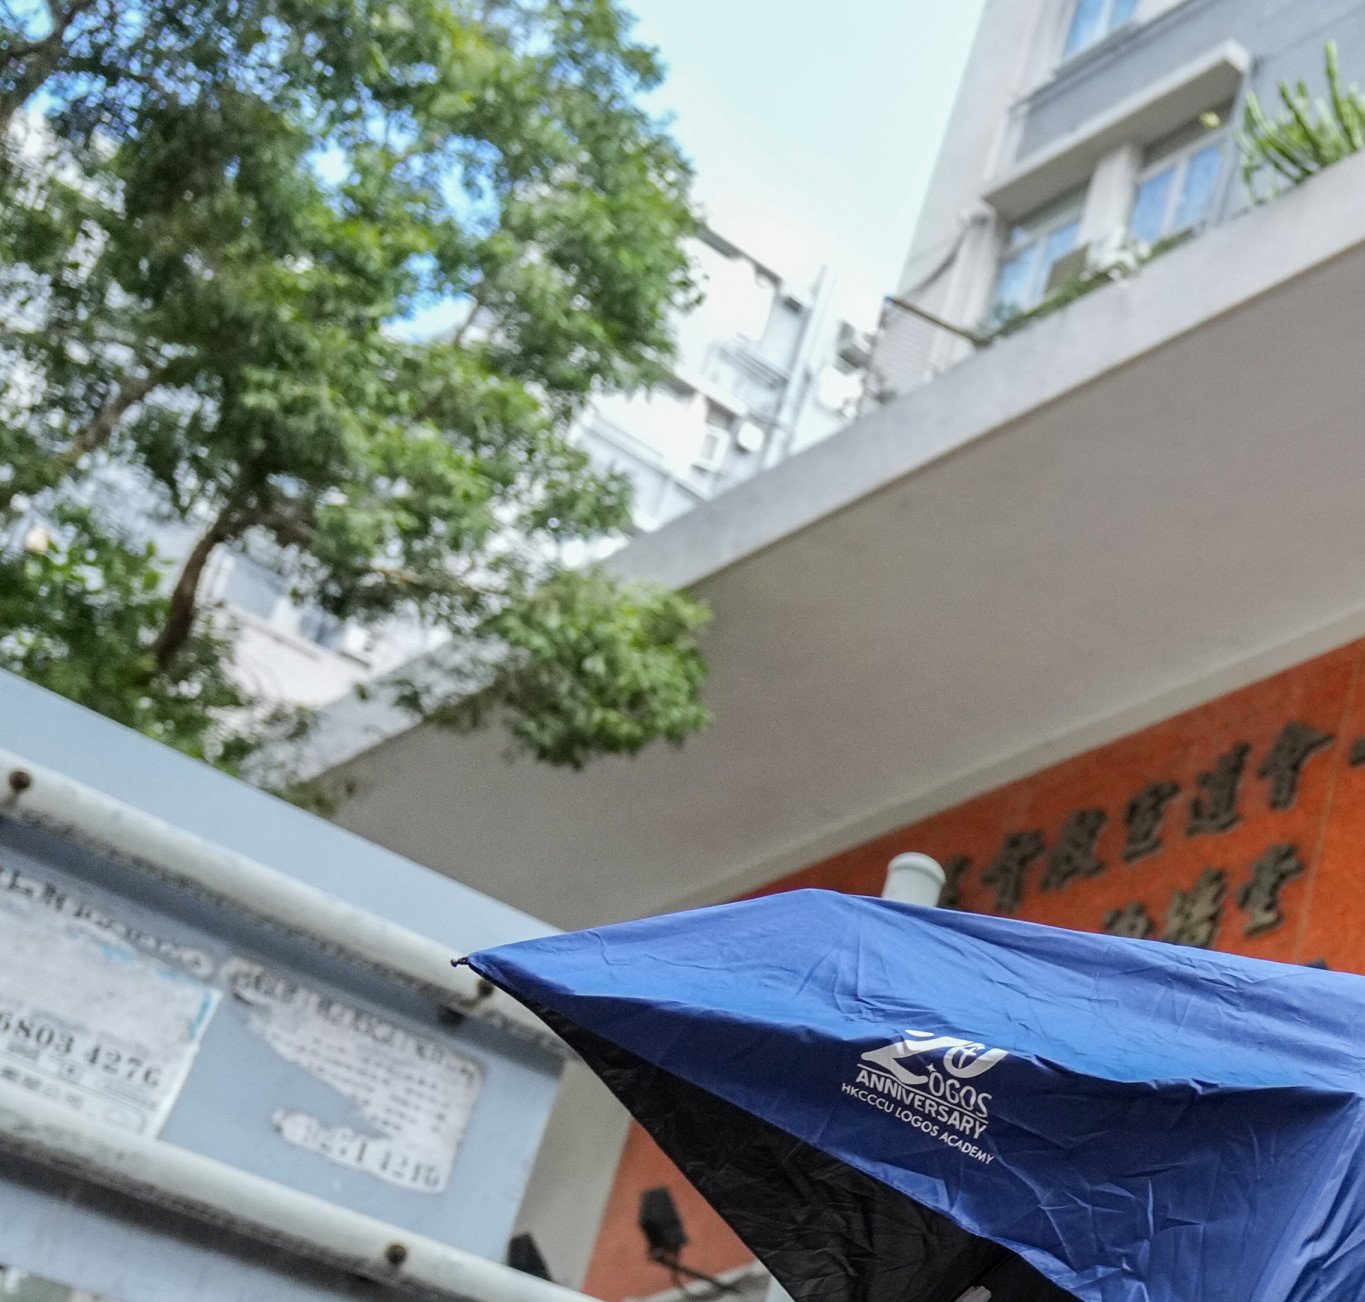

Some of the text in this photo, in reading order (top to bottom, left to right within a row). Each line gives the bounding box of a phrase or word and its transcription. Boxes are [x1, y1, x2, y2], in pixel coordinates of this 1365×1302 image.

[841, 1082, 995, 1165] HKCCCU LOGOS ACADEMY
[855, 1069, 987, 1139] ANNIVERSARY
